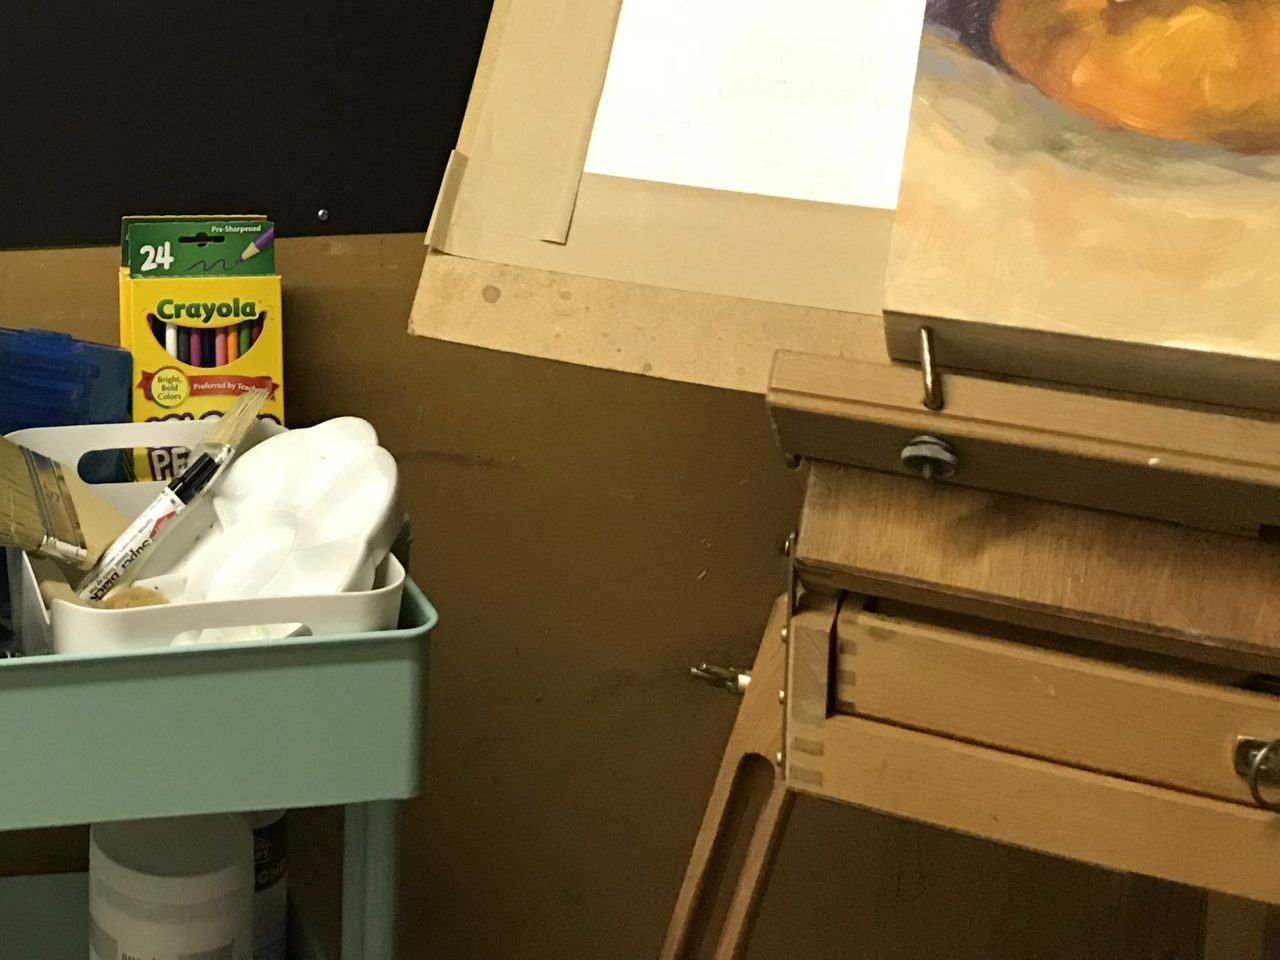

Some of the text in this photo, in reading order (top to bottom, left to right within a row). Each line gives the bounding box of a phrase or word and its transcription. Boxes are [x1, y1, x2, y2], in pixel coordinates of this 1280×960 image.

[211, 224, 262, 234] Pre-Sharpened
[139, 241, 175, 272] 24
[156, 297, 257, 324] Crayola
[161, 384, 179, 392] Bold
[193, 381, 226, 391] Preferred
[227, 381, 236, 391] by
[157, 392, 182, 400] Colors
